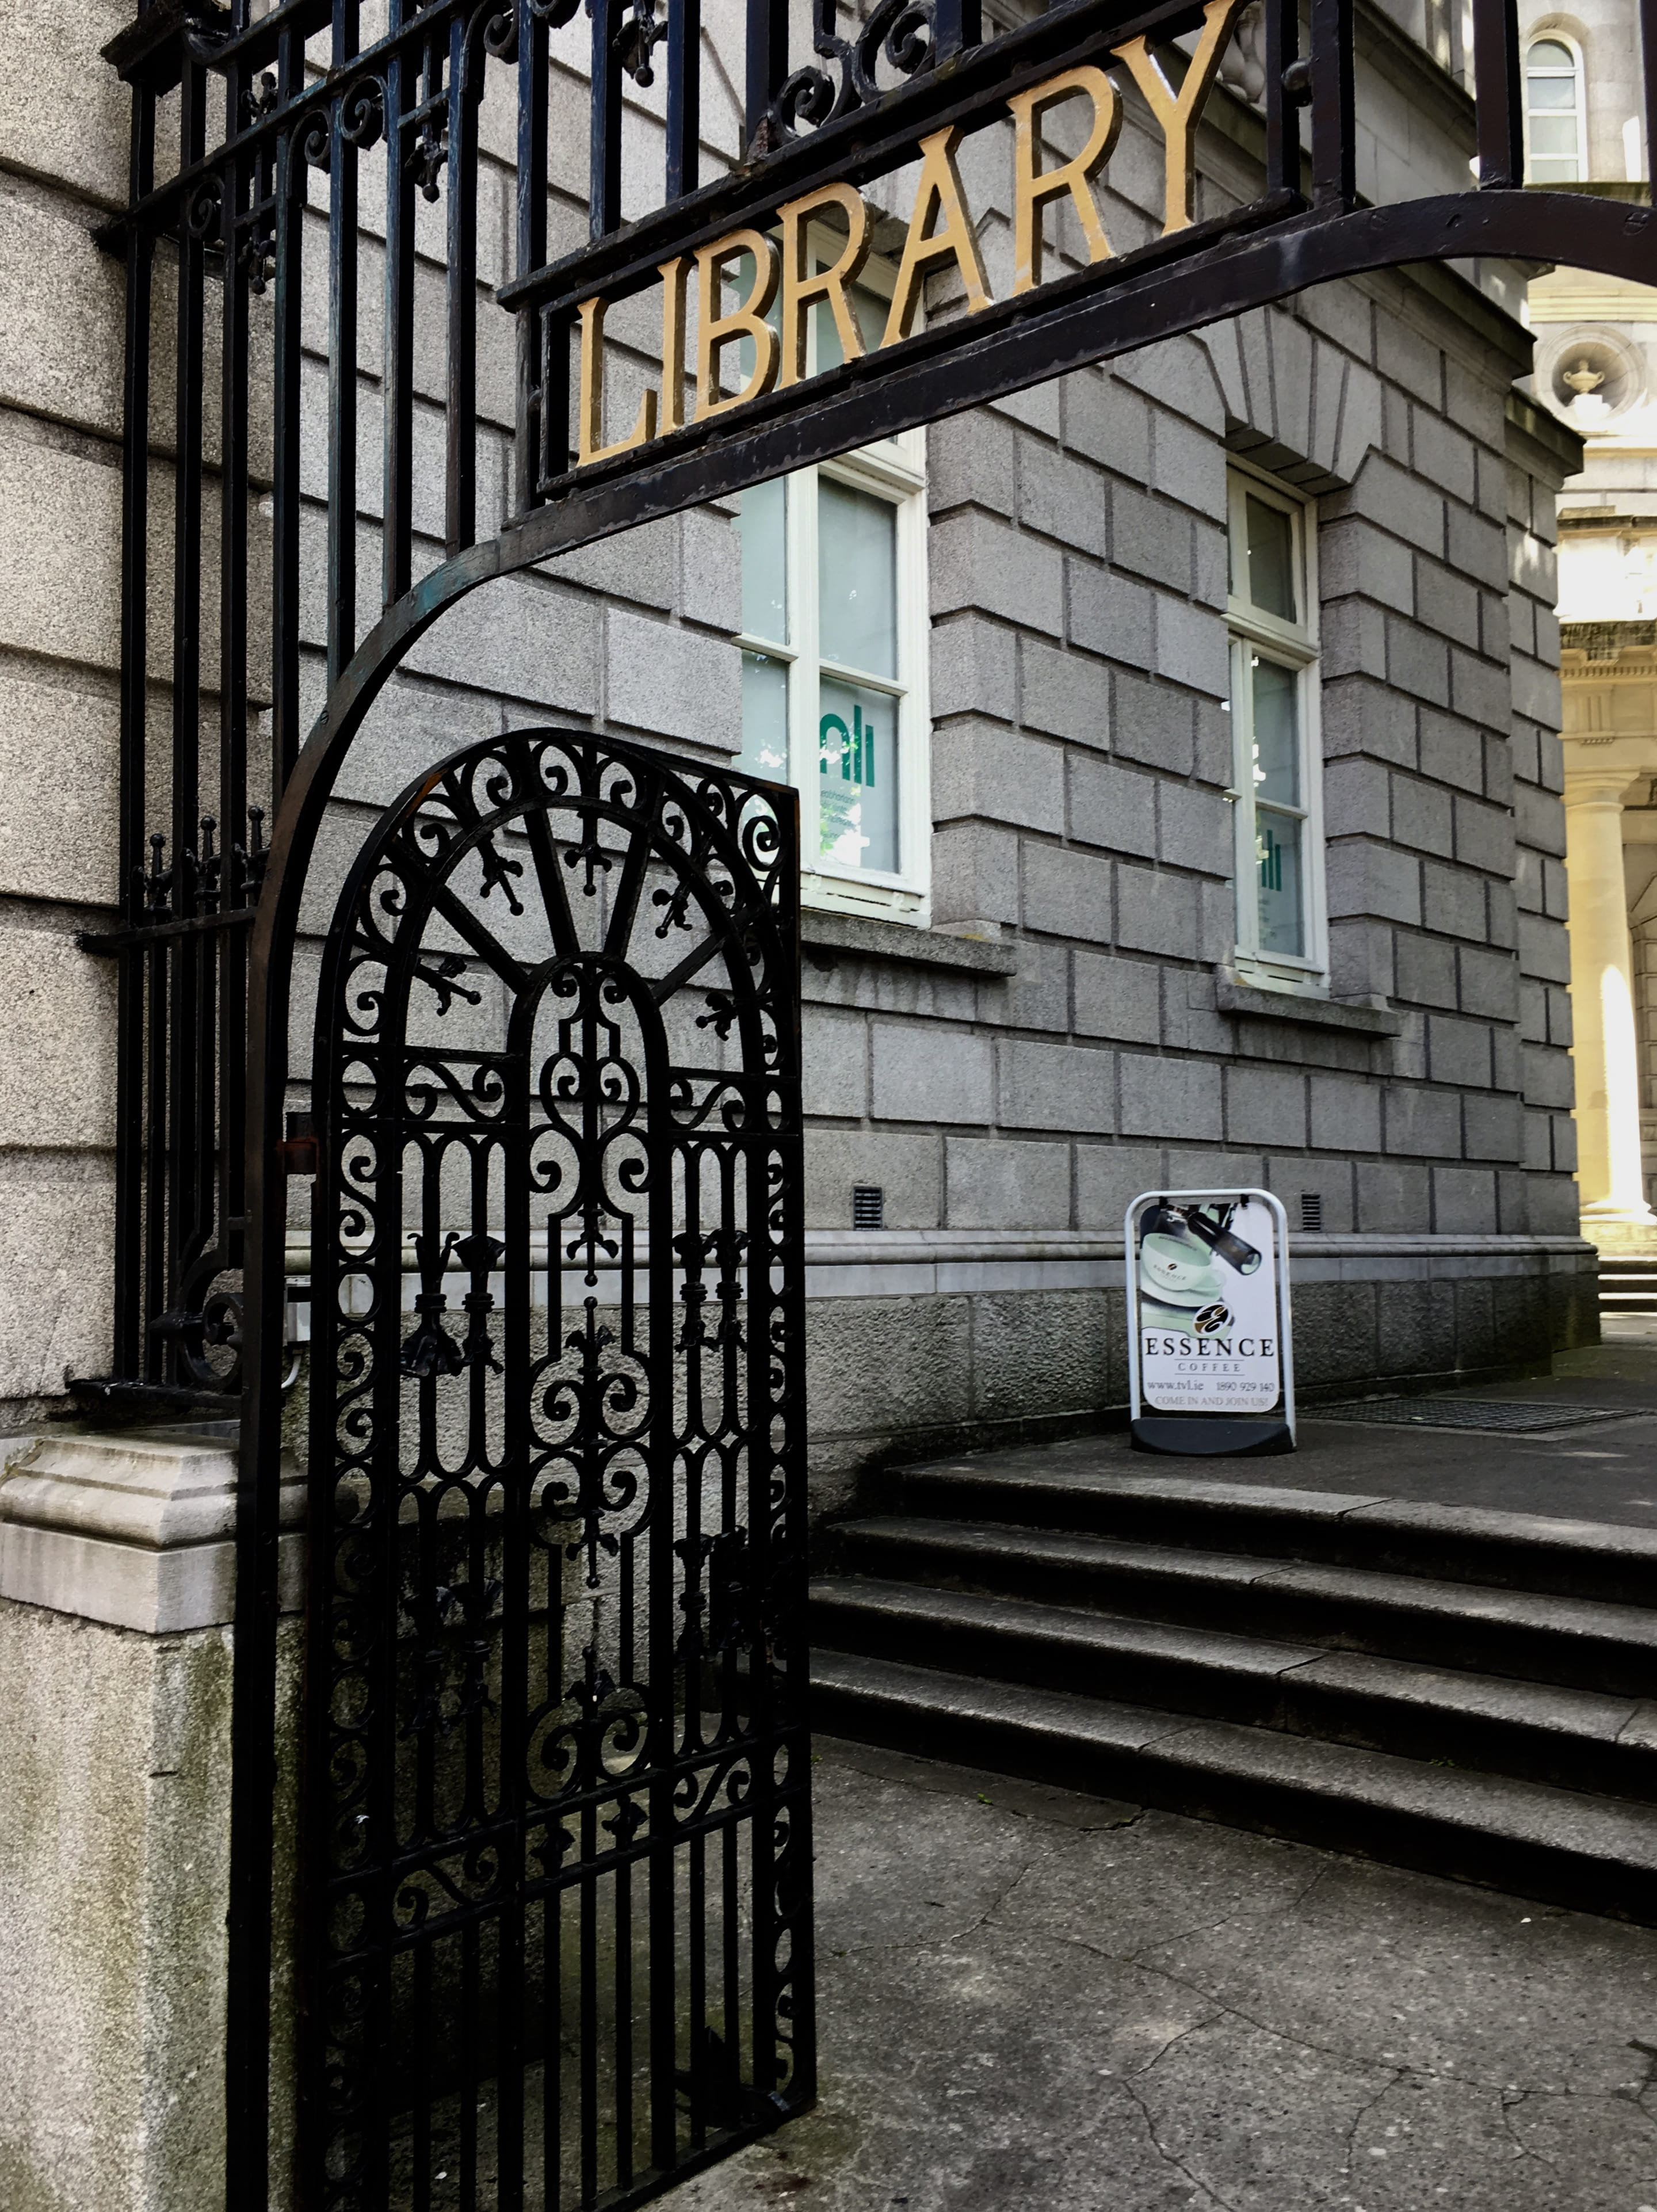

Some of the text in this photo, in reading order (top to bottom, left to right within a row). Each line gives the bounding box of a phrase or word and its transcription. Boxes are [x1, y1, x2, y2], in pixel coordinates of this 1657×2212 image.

[577, 0, 1246, 467] LIBRARY
[1145, 1338, 1274, 1356] ESSENCE
[1178, 1363, 1240, 1371] COFFEE
[1216, 1382, 1237, 1391] 1890
[1240, 1382, 1257, 1391] 929
[1259, 1382, 1276, 1392] 140
[1155, 1396, 1269, 1406] COME IN AND JOIN US!
